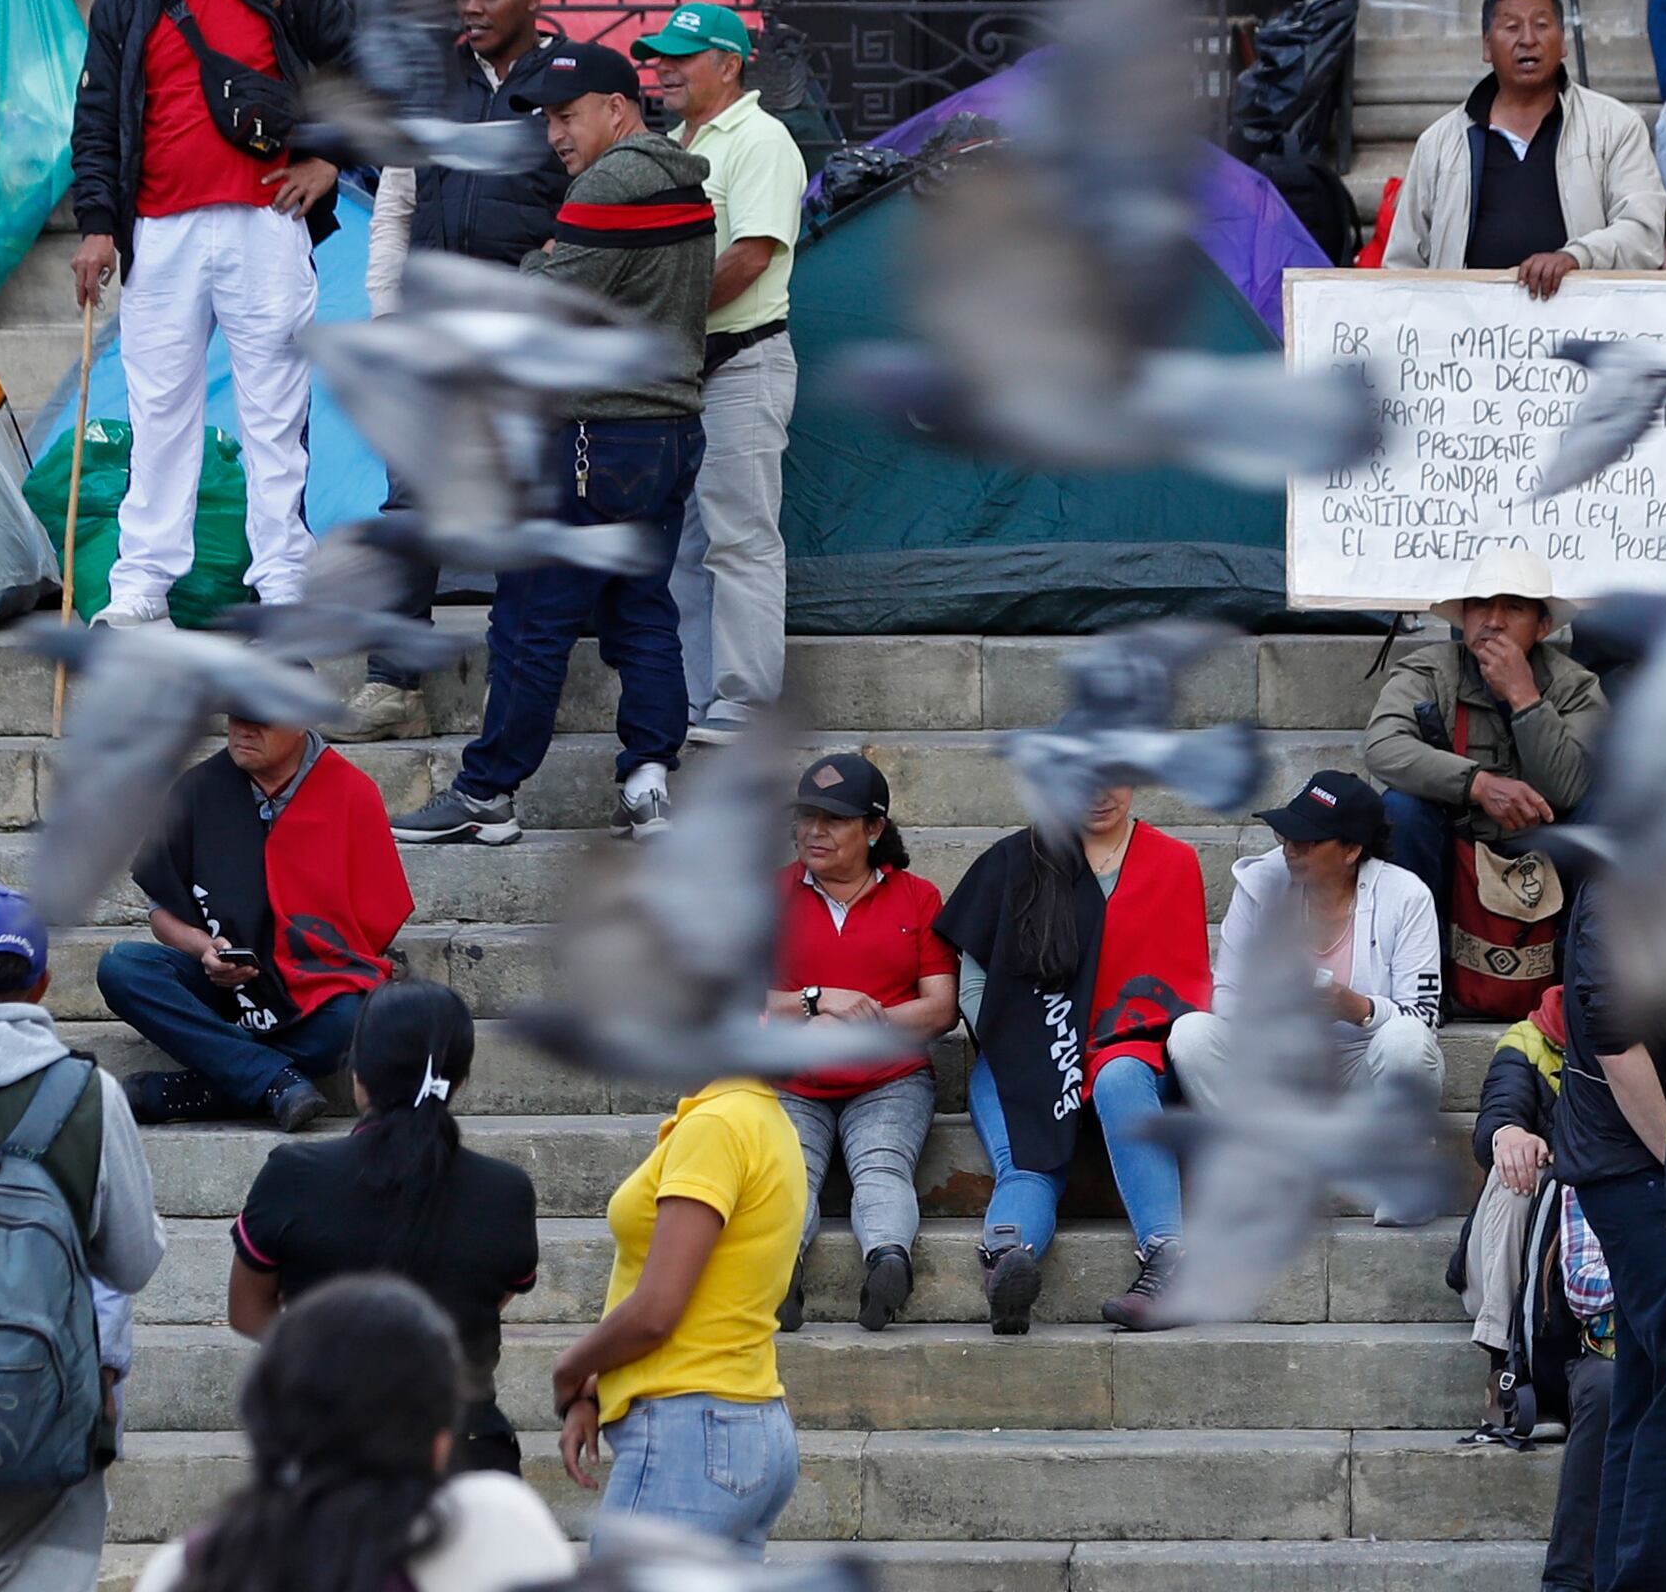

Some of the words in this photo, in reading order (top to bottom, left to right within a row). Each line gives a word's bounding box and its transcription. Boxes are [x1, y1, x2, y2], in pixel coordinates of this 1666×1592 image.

[1333, 322, 1371, 356] POR
[1397, 324, 1419, 357] LA
[1400, 358, 1472, 392] PUNTO
[1495, 361, 1588, 394] DÉCIMO
[1473, 399, 1503, 425] DE
[1417, 429, 1537, 463] PRESIDENTE
[1364, 461, 1395, 493] SE
[1516, 464, 1544, 493] EN
[1569, 467, 1655, 497] ARCHA
[1532, 498, 1559, 526] LA
[1341, 527, 1366, 557] EL
[1548, 533, 1585, 560] DEL
